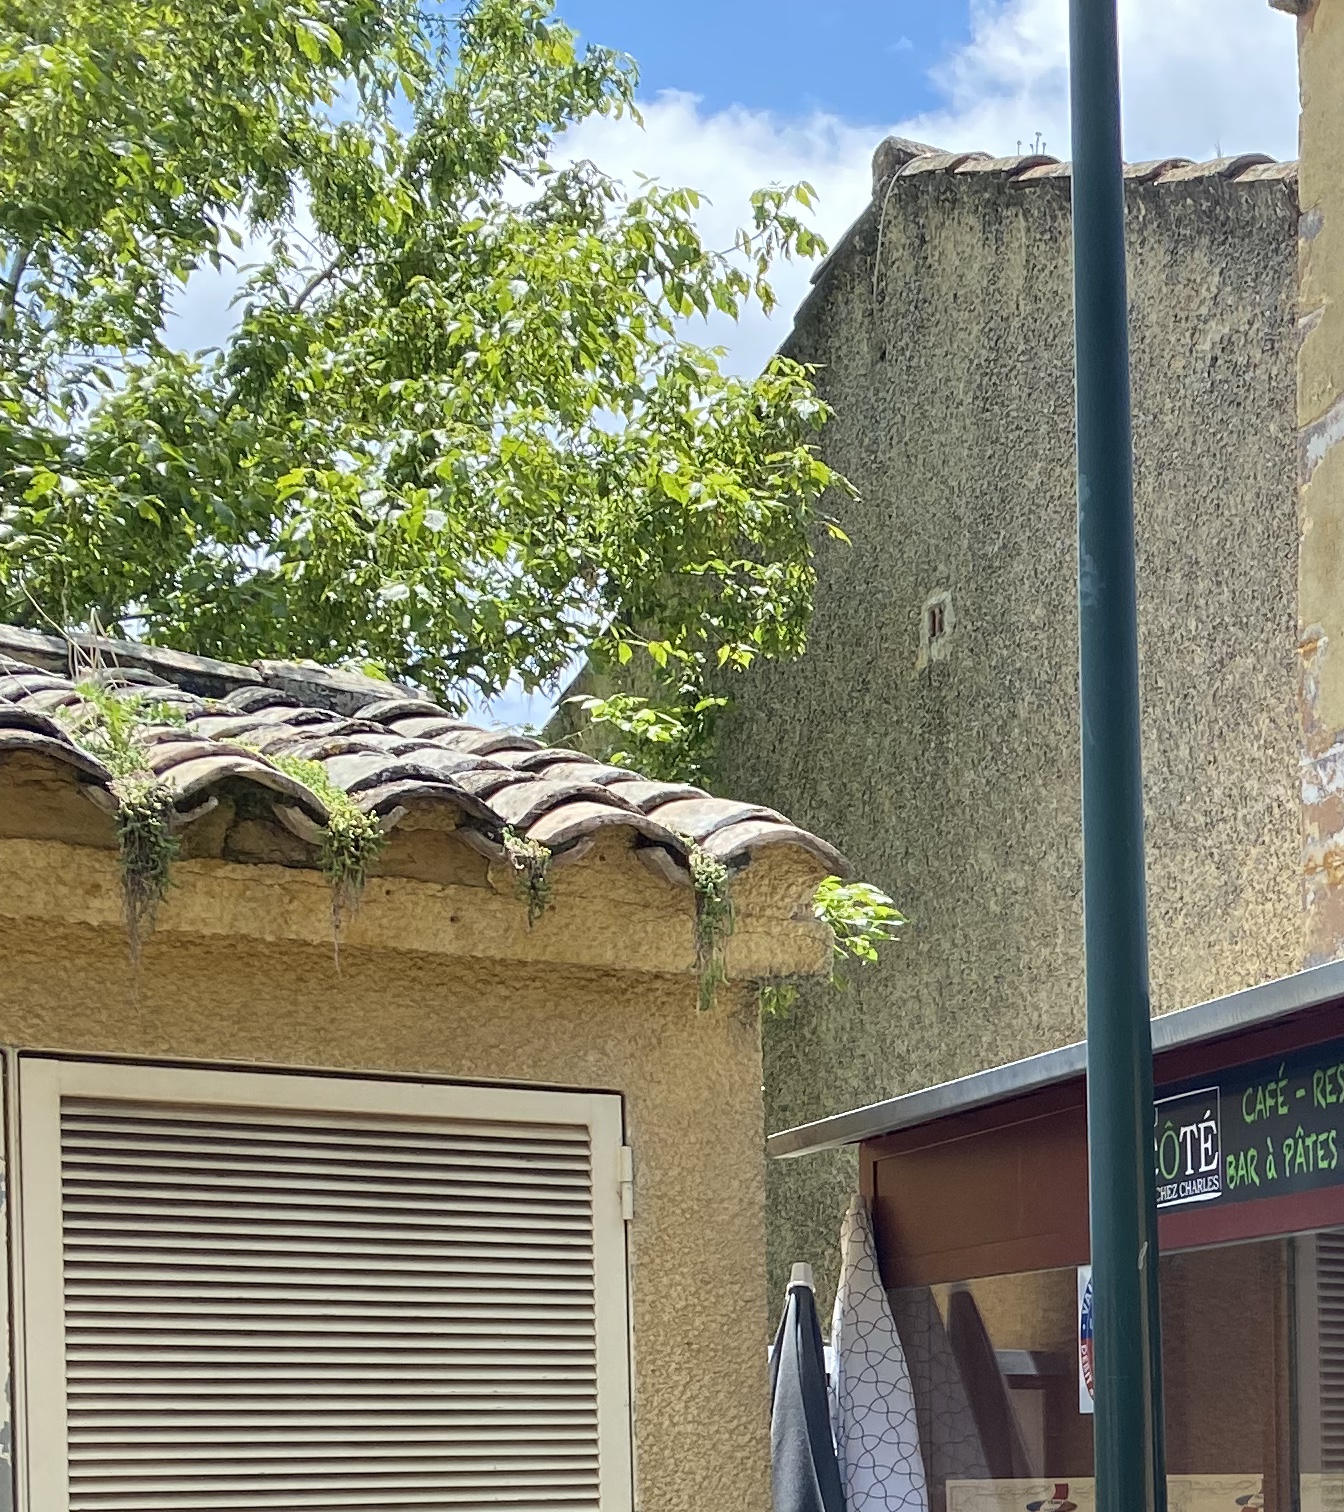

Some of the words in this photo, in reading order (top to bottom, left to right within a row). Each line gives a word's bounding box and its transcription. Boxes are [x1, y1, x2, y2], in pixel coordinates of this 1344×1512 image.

[1242, 1062, 1289, 1124] CAFÉ
[1154, 1110, 1219, 1179] ÔTÉ
[1227, 1148, 1258, 1191] BAR
[1283, 1125, 1338, 1179] PÂTES
[1179, 1175, 1219, 1197] CHARLES
